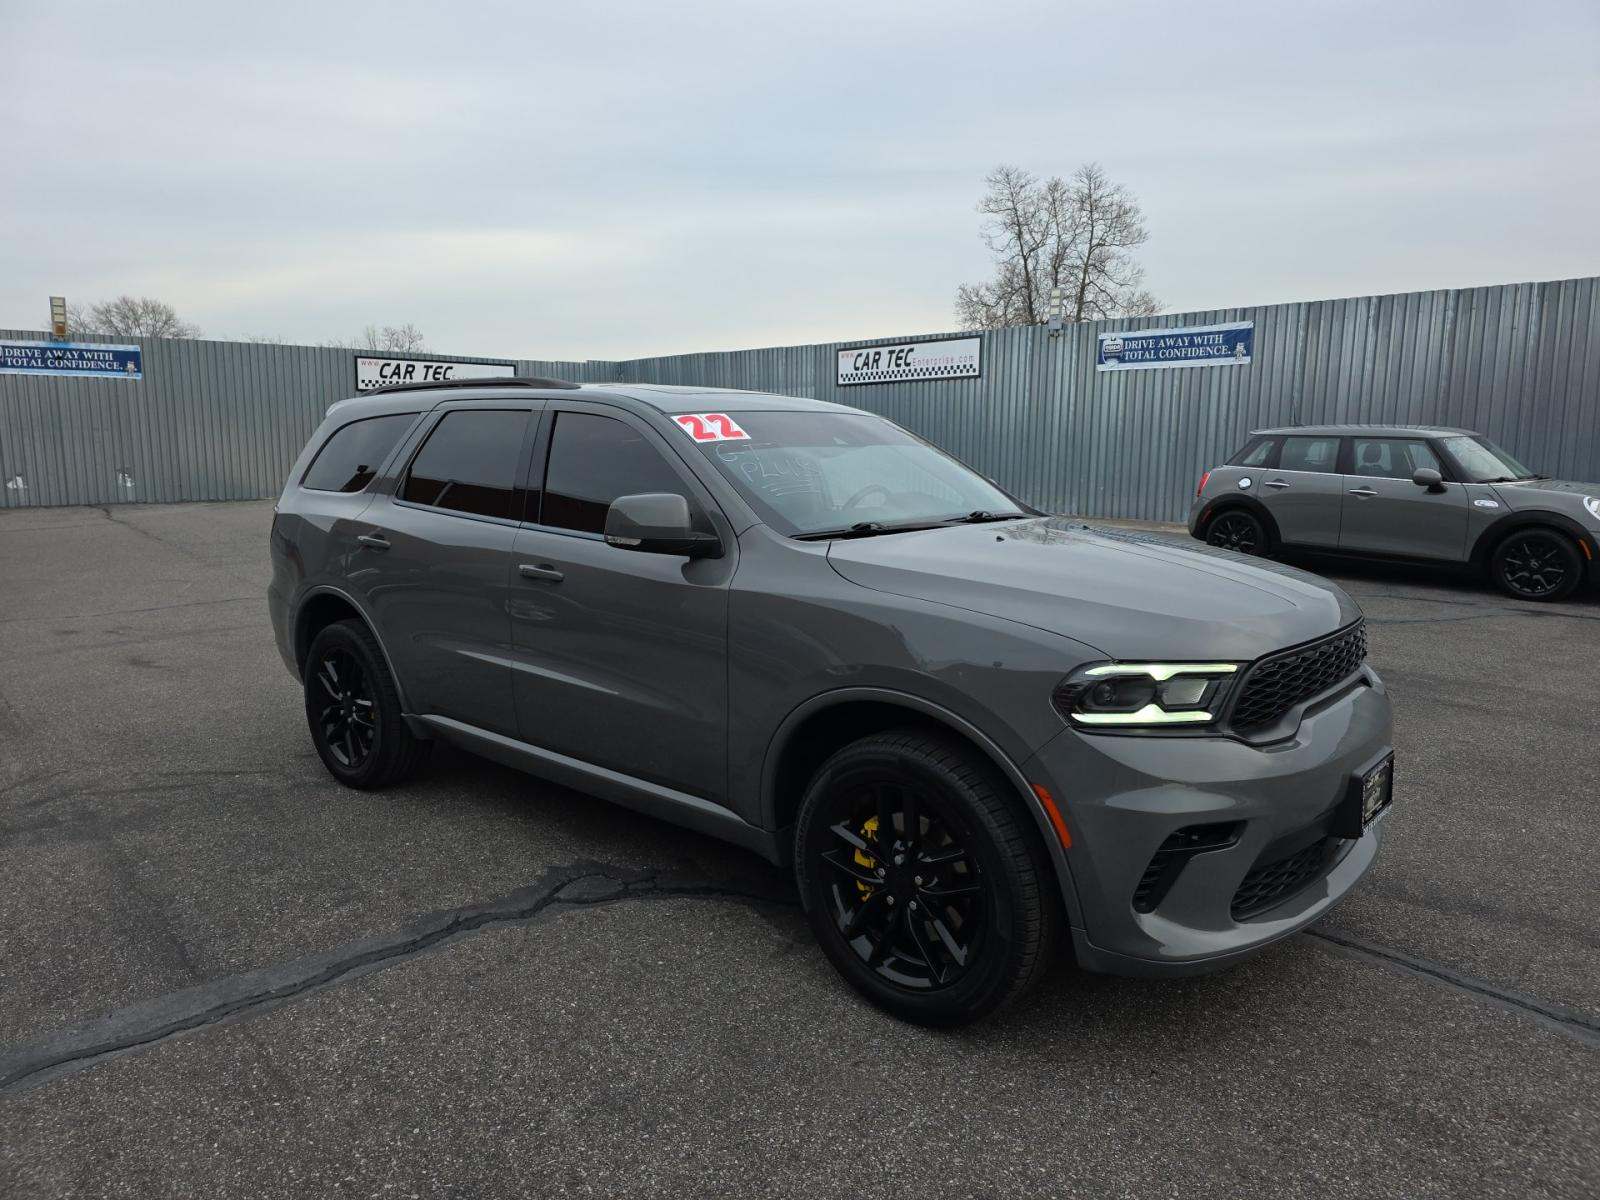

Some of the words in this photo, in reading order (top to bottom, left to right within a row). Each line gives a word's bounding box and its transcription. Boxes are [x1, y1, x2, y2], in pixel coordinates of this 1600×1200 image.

[1125, 339, 1155, 350] DRIVE
[1158, 337, 1191, 347] AWAY
[1194, 334, 1223, 345] WITH
[5, 348, 41, 358] DRIVE
[45, 350, 80, 360] AWAY
[83, 351, 113, 361] WITH
[853, 351, 882, 371] CAR
[887, 347, 914, 369] TEC
[1125, 350, 1156, 360] TOTAL
[1159, 345, 1231, 358] CONFIDENCE.
[6, 358, 44, 367] TOTAL
[379, 362, 415, 380] CAR
[423, 365, 453, 381] TEC
[677, 414, 743, 440] 22
